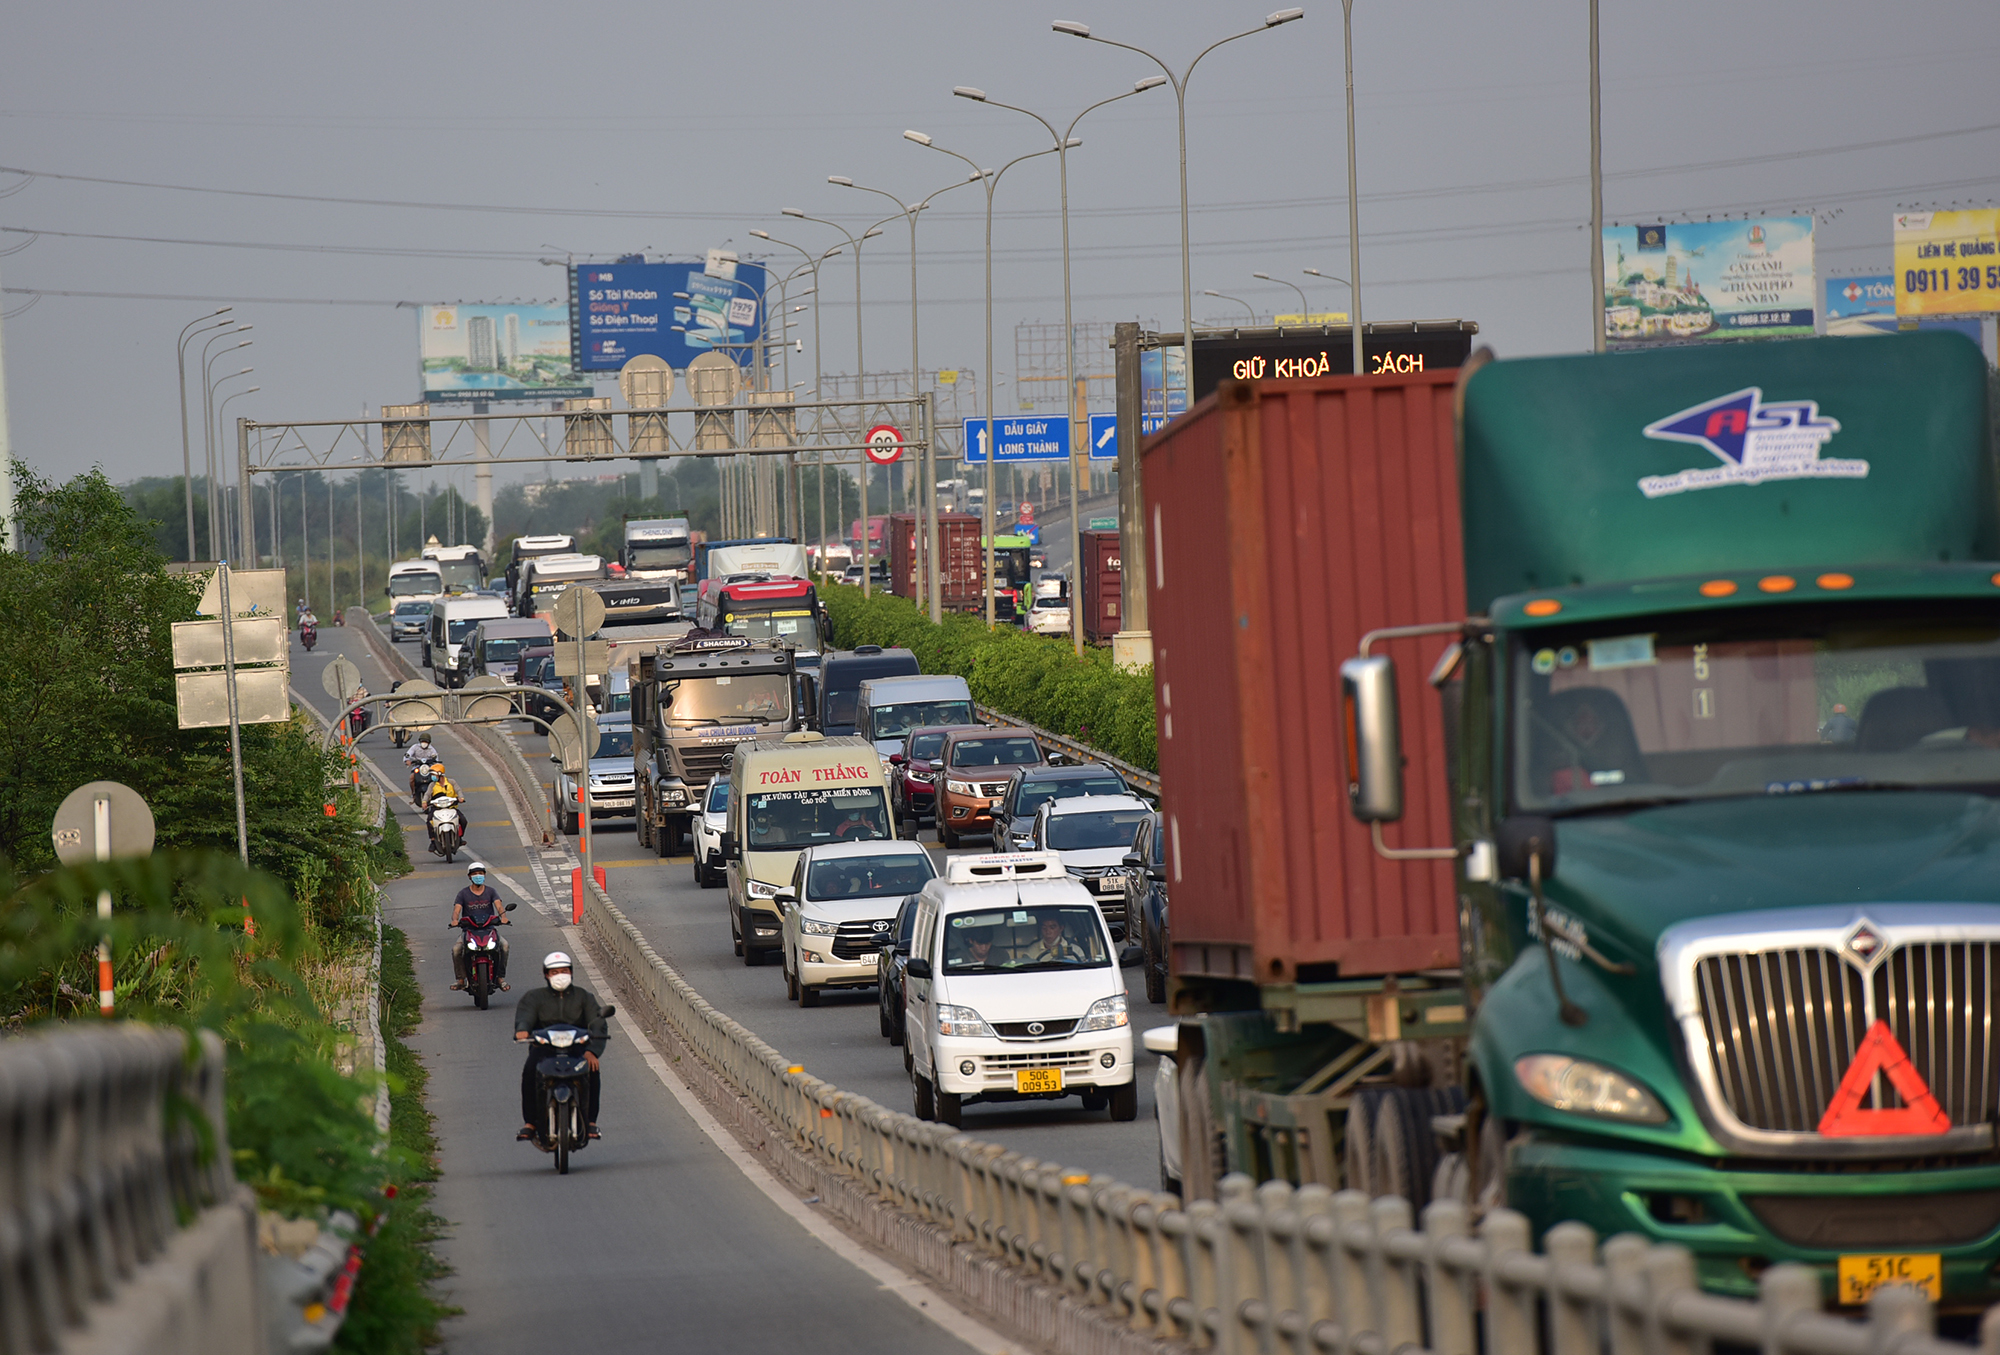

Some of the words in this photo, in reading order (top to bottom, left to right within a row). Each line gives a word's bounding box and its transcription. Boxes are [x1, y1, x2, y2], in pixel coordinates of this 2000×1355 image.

[1917, 242, 1941, 259] LIÊN
[1944, 241, 1956, 261] HỆ
[1960, 238, 1996, 258] QUẢNG
[598, 272, 613, 282] MB
[1905, 267, 1950, 293] 0911
[1957, 266, 1980, 291] 39
[1986, 265, 2000, 290] 5
[589, 289, 604, 301] Số
[605, 288, 621, 300] Tài
[622, 288, 658, 300] Khoản
[1864, 281, 1895, 299] TÔN
[732, 300, 753, 313] 7979
[590, 314, 604, 326] Số
[605, 313, 629, 326] Điện
[630, 313, 659, 326] Thoại
[1232, 355, 1267, 380] GIỮ
[1026, 420, 1048, 435] GIÂY
[999, 443, 1025, 455] LONG
[1026, 439, 1059, 454] THÀNH
[703, 639, 742, 648] SHACMAN
[759, 767, 802, 785] TOÀN
[812, 762, 869, 782] THẮNG
[793, 790, 808, 800] TÀU
[852, 787, 872, 797] ĐÔNG
[815, 796, 827, 804] TỐC
[1107, 877, 1119, 885] 51K
[862, 955, 877, 964] 64A
[1030, 1070, 1049, 1081] 50G
[1022, 1080, 1057, 1092] 009.53
[1867, 1257, 1912, 1278] 51C
